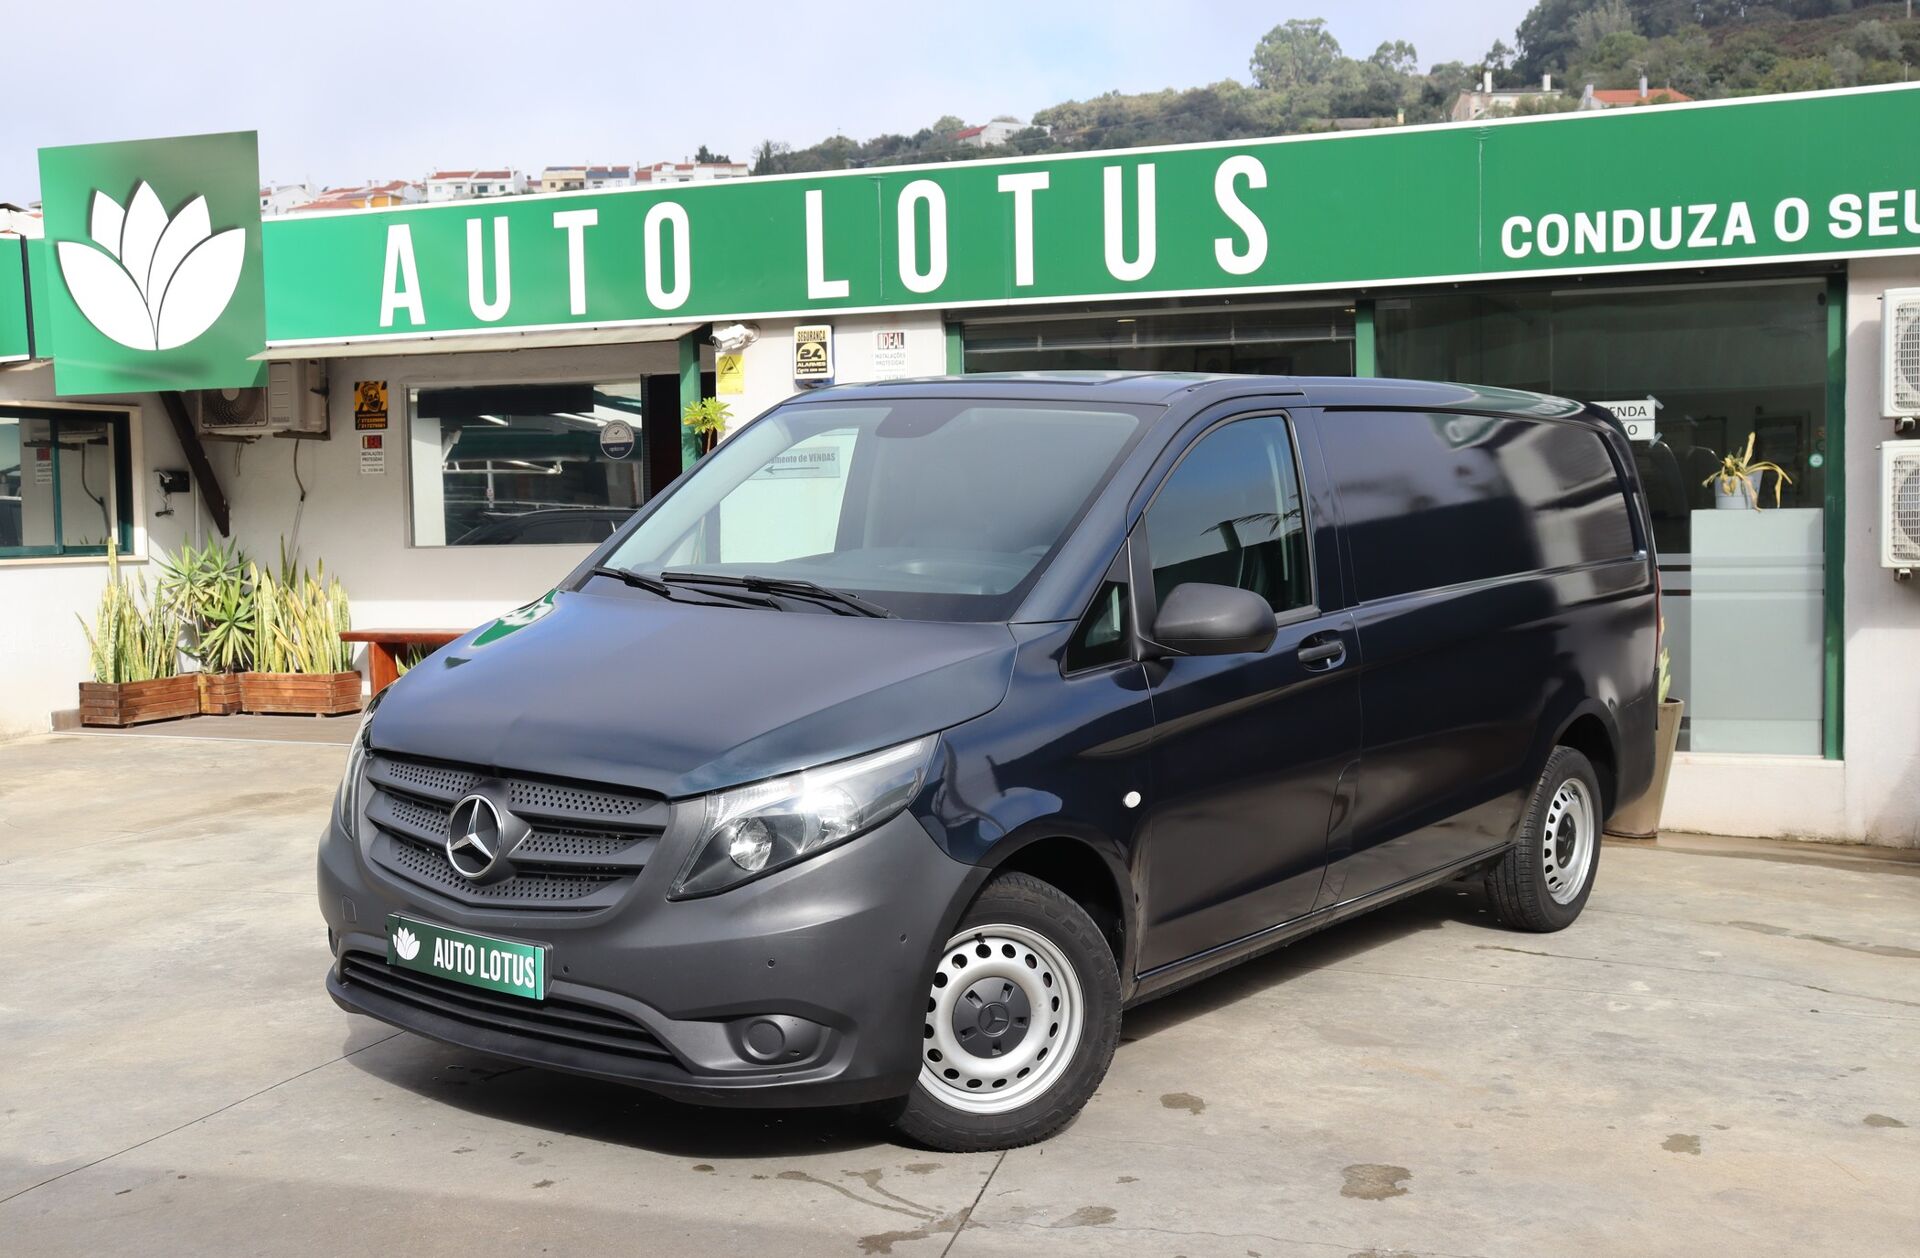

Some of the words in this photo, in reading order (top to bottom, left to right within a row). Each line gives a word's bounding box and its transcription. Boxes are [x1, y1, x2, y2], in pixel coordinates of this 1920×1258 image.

[379, 201, 691, 328] AUTO
[805, 154, 1268, 300] LOTUS
[1501, 201, 1756, 259] CONDUZA
[1775, 197, 1810, 242] O
[800, 348, 822, 360] 24
[798, 454, 808, 463] de
[809, 453, 835, 463] VENDAS
[433, 937, 475, 976] AUTO
[480, 947, 535, 989] LOTUS
